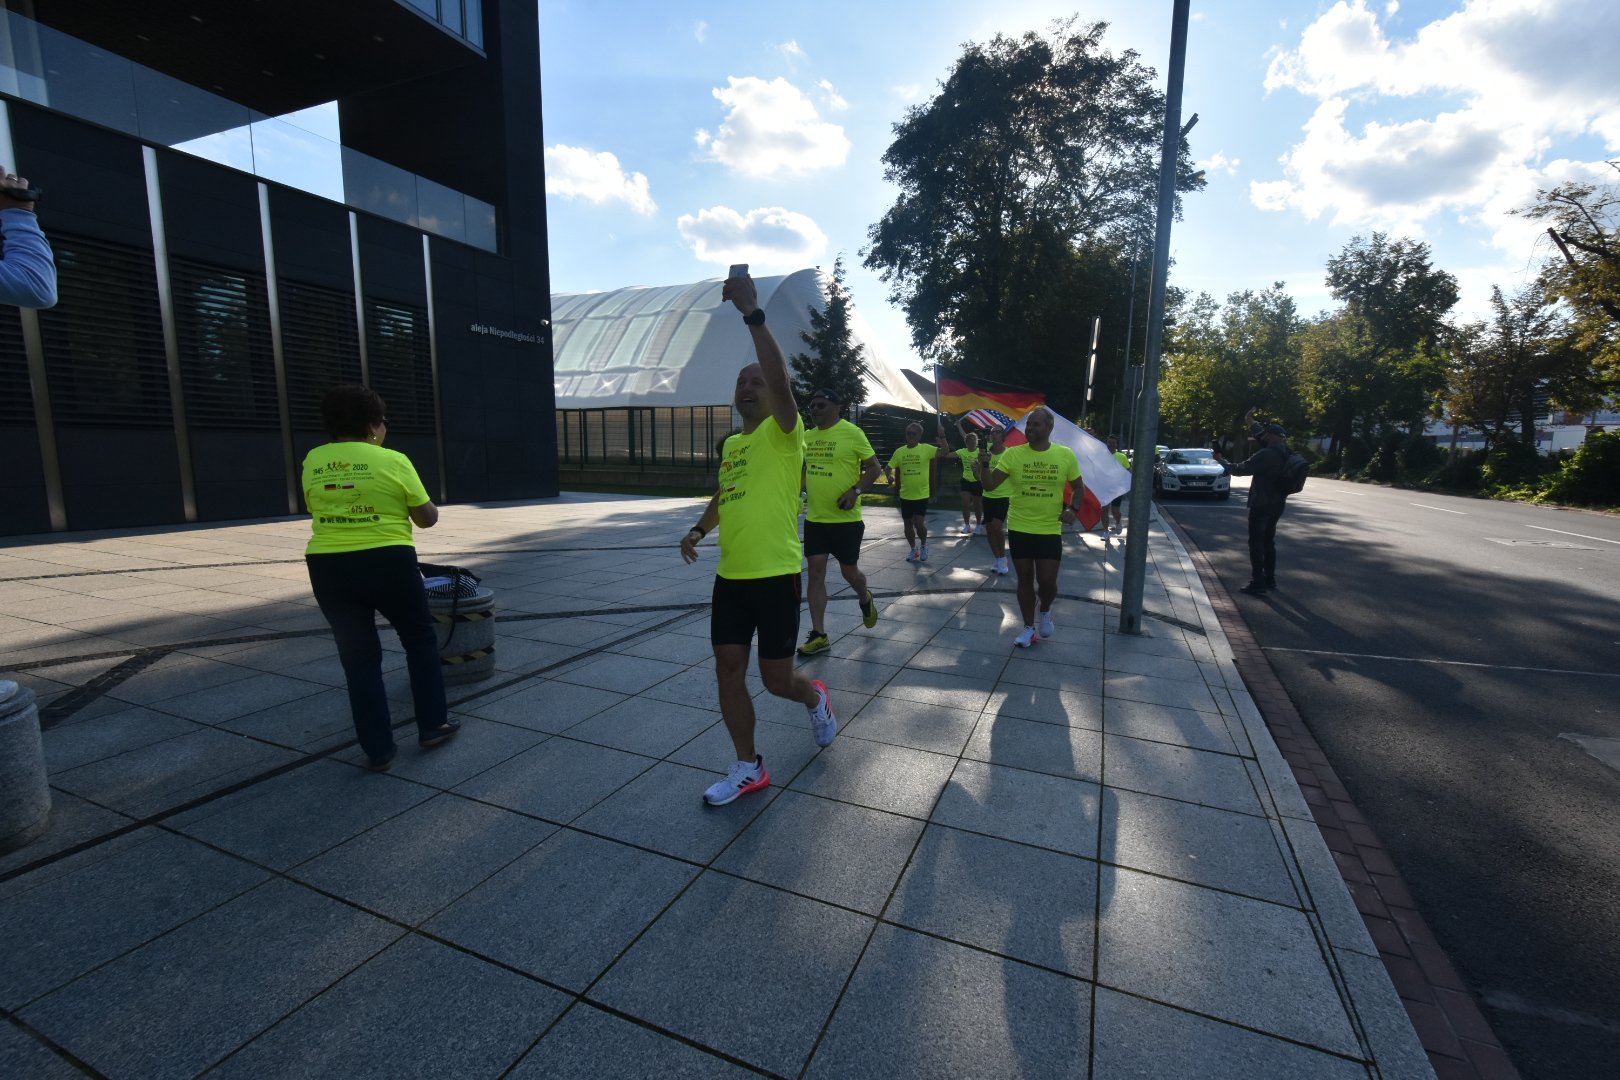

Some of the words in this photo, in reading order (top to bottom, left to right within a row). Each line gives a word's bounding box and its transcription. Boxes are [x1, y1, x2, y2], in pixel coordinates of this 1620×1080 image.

[470, 323, 488, 335] aleja
[489, 326, 535, 343] Niepodległości
[536, 335, 545, 345] 34
[313, 467, 324, 476] 1945
[352, 463, 369, 471] 2020
[351, 505, 363, 513] 675
[364, 505, 375, 513] km
[326, 516, 335, 524] WE
